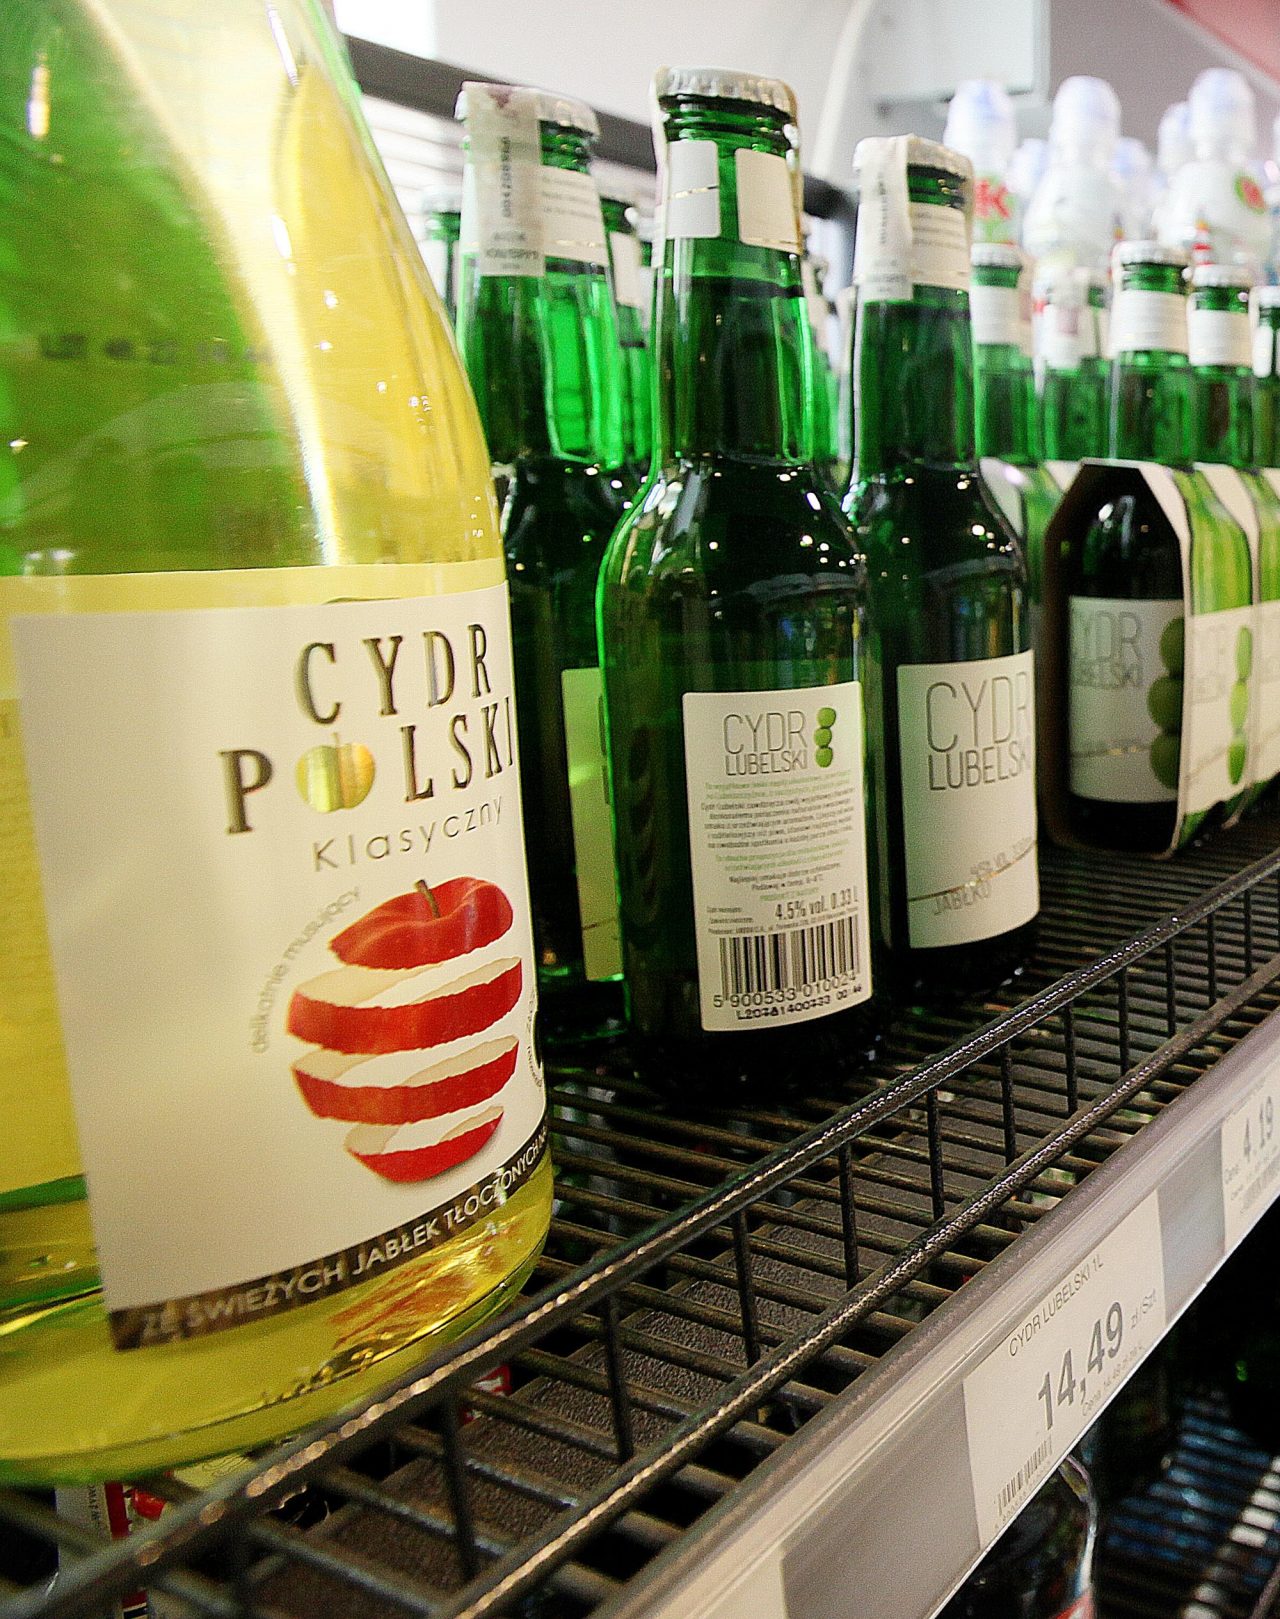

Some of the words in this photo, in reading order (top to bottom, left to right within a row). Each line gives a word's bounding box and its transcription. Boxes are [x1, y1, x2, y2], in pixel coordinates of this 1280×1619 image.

[294, 623, 492, 725] CYDR
[926, 671, 1031, 753] CYDR
[218, 697, 514, 836] POLSKI
[723, 710, 808, 755] CYDR
[725, 750, 808, 776] LUBELSKI
[313, 796, 503, 872] Klasyczny
[713, 995, 724, 1008] 5
[730, 988, 797, 1008] 900533
[352, 1218, 439, 1276] JABŁEK
[443, 1138, 540, 1230] TŁOCZONYCH
[1009, 1314, 1041, 1356] CYDR
[1042, 1263, 1091, 1324] LUBELSKI
[1092, 1253, 1104, 1272] 1L
[1037, 1301, 1123, 1431] 14,49
